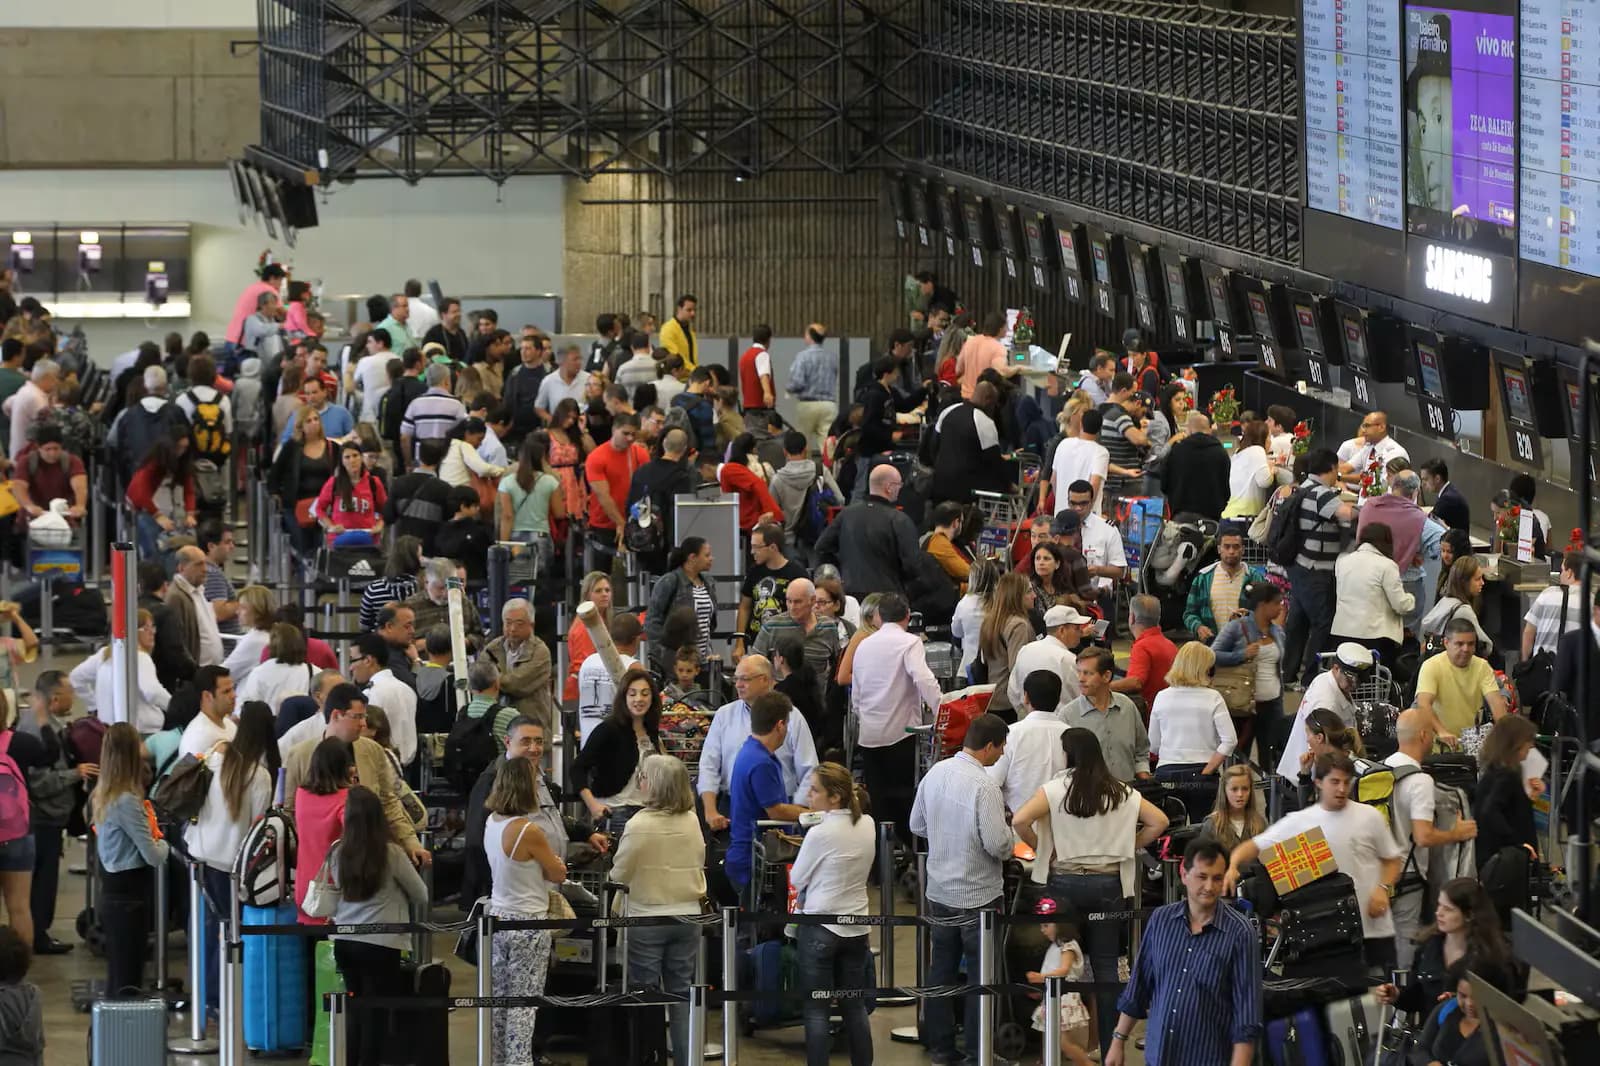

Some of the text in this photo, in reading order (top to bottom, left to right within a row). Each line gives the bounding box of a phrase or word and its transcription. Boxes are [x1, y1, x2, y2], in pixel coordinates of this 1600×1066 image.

[1426, 244, 1493, 304] SAMSUNG
[1309, 359, 1323, 385] B17
[1428, 402, 1445, 433] B19
[1516, 431, 1534, 461] B20
